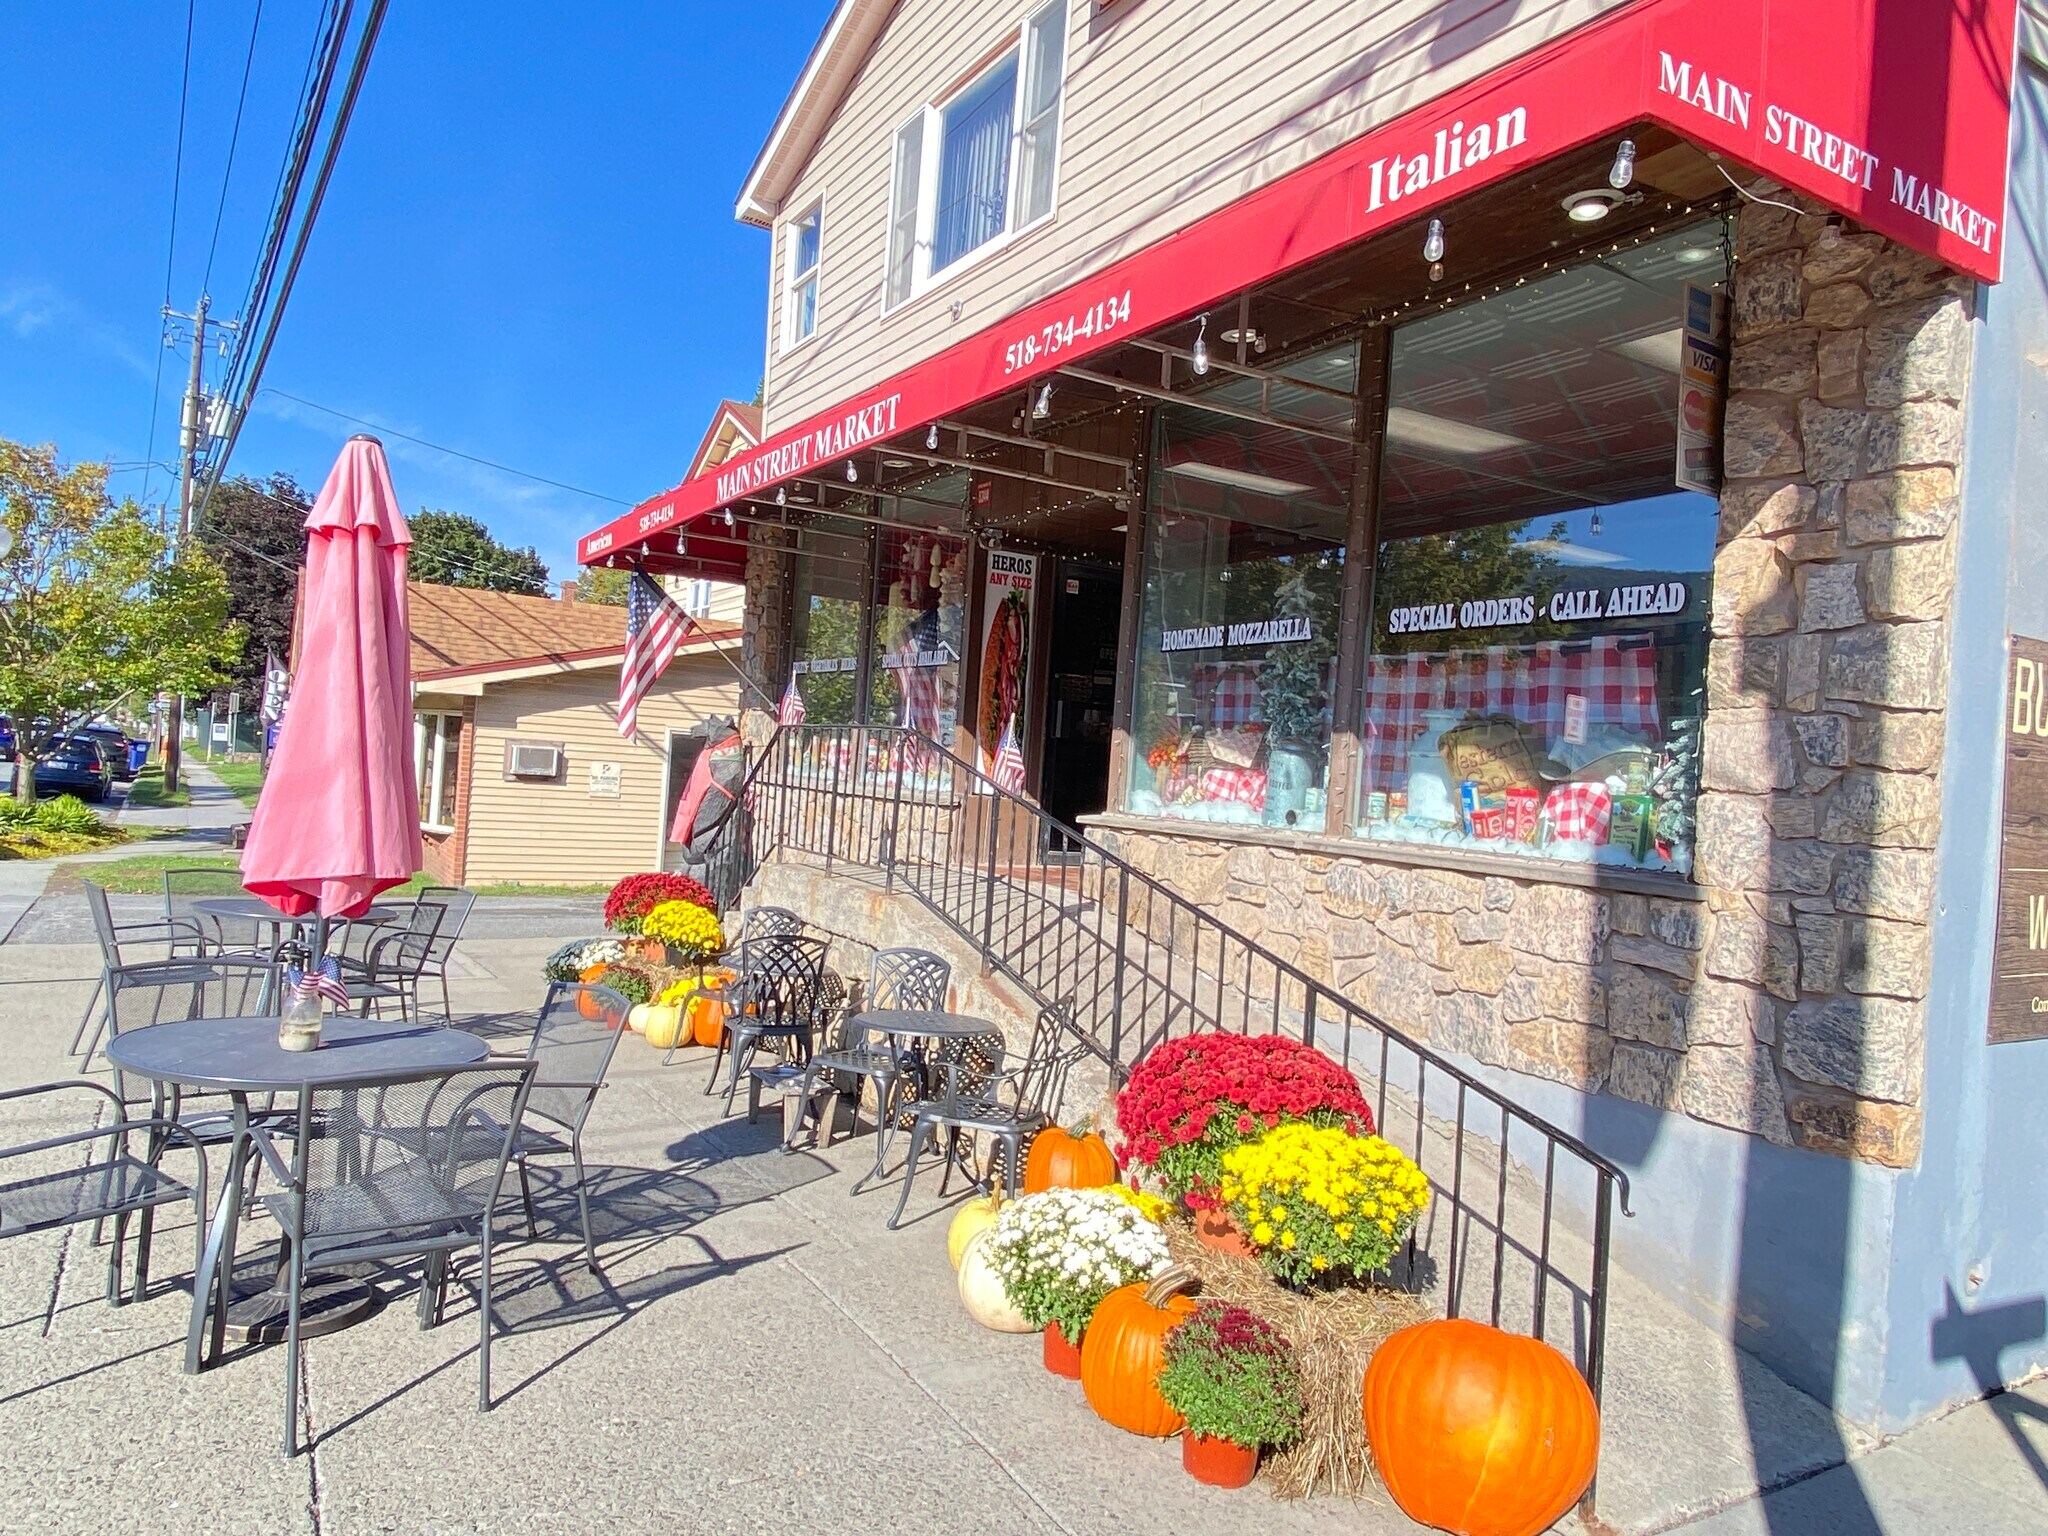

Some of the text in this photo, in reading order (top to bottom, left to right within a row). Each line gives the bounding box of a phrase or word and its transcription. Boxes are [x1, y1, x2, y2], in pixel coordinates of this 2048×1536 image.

[1365, 105, 1527, 214] Italian
[1658, 51, 1996, 254] MAIN STREET MARKET
[1004, 289, 1131, 375] 518-734-4134
[1692, 351, 1717, 375] VISA
[716, 393, 901, 504] MAIN STREET MARKET
[989, 572, 1033, 590] ANY SIZE
[991, 553, 1033, 576] HEROS
[1389, 603, 1457, 633] SPECIAL
[1460, 595, 1535, 628] ORDERS
[1550, 589, 1602, 621] CALL
[1605, 582, 1686, 618] AHEAD
[1161, 617, 1312, 651] HOMEMADE MOZZARELLA
